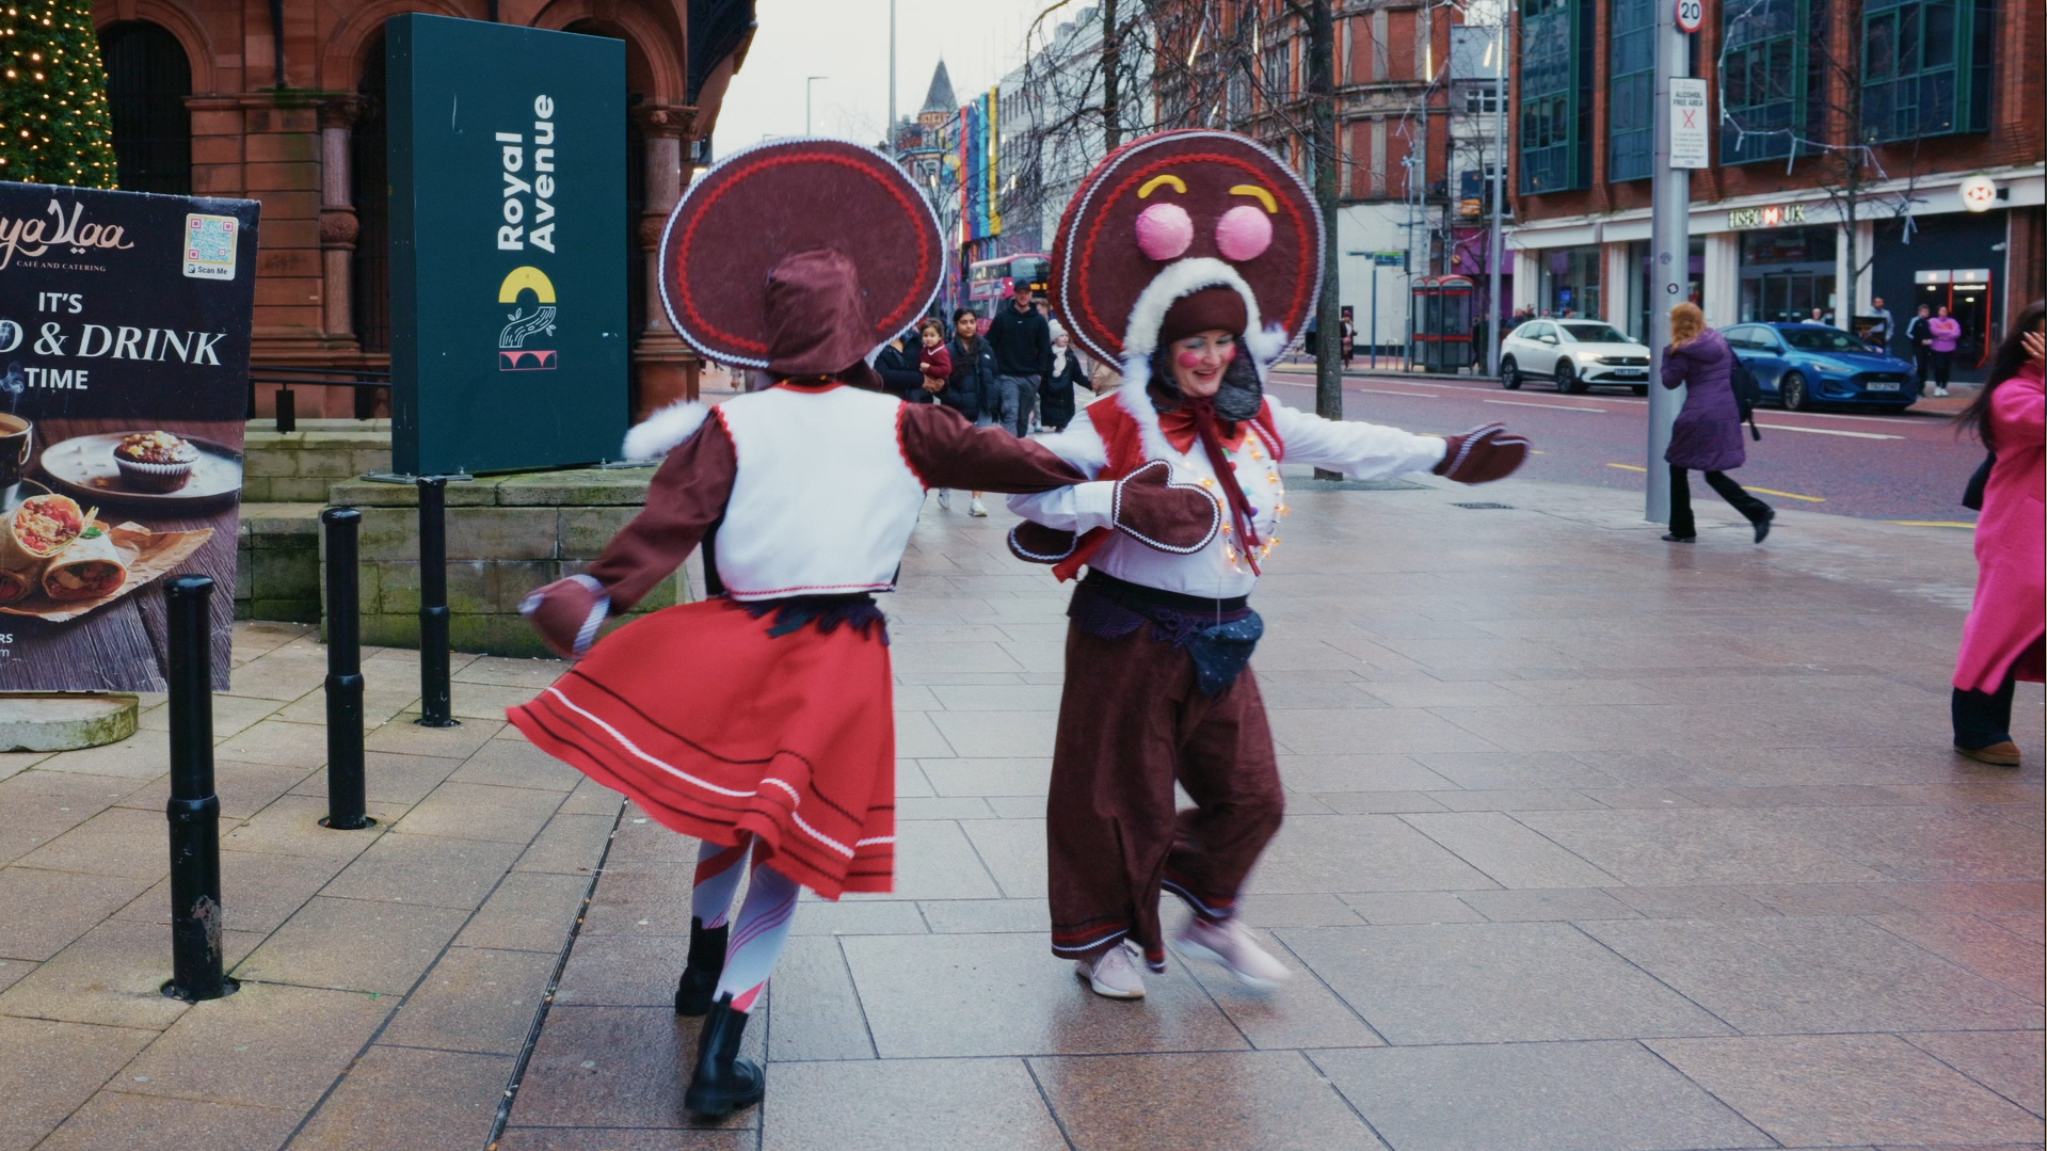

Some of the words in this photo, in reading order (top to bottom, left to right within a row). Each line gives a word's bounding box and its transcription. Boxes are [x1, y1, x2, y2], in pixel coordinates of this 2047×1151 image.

[1681, 2, 1700, 20] 20
[1673, 98, 1687, 106] FREE
[1688, 99, 1704, 107] AREA
[530, 94, 555, 254] Avenue
[496, 132, 531, 250] Royal
[16, 260, 39, 268] CAFÉ
[40, 262, 60, 270] AND
[62, 264, 106, 272] CATERING
[197, 266, 214, 275] Scan
[216, 267, 228, 275] Me
[38, 292, 83, 313] IT'S
[33, 322, 69, 356] &
[75, 323, 227, 366] DRINK
[24, 367, 89, 390] TIME
